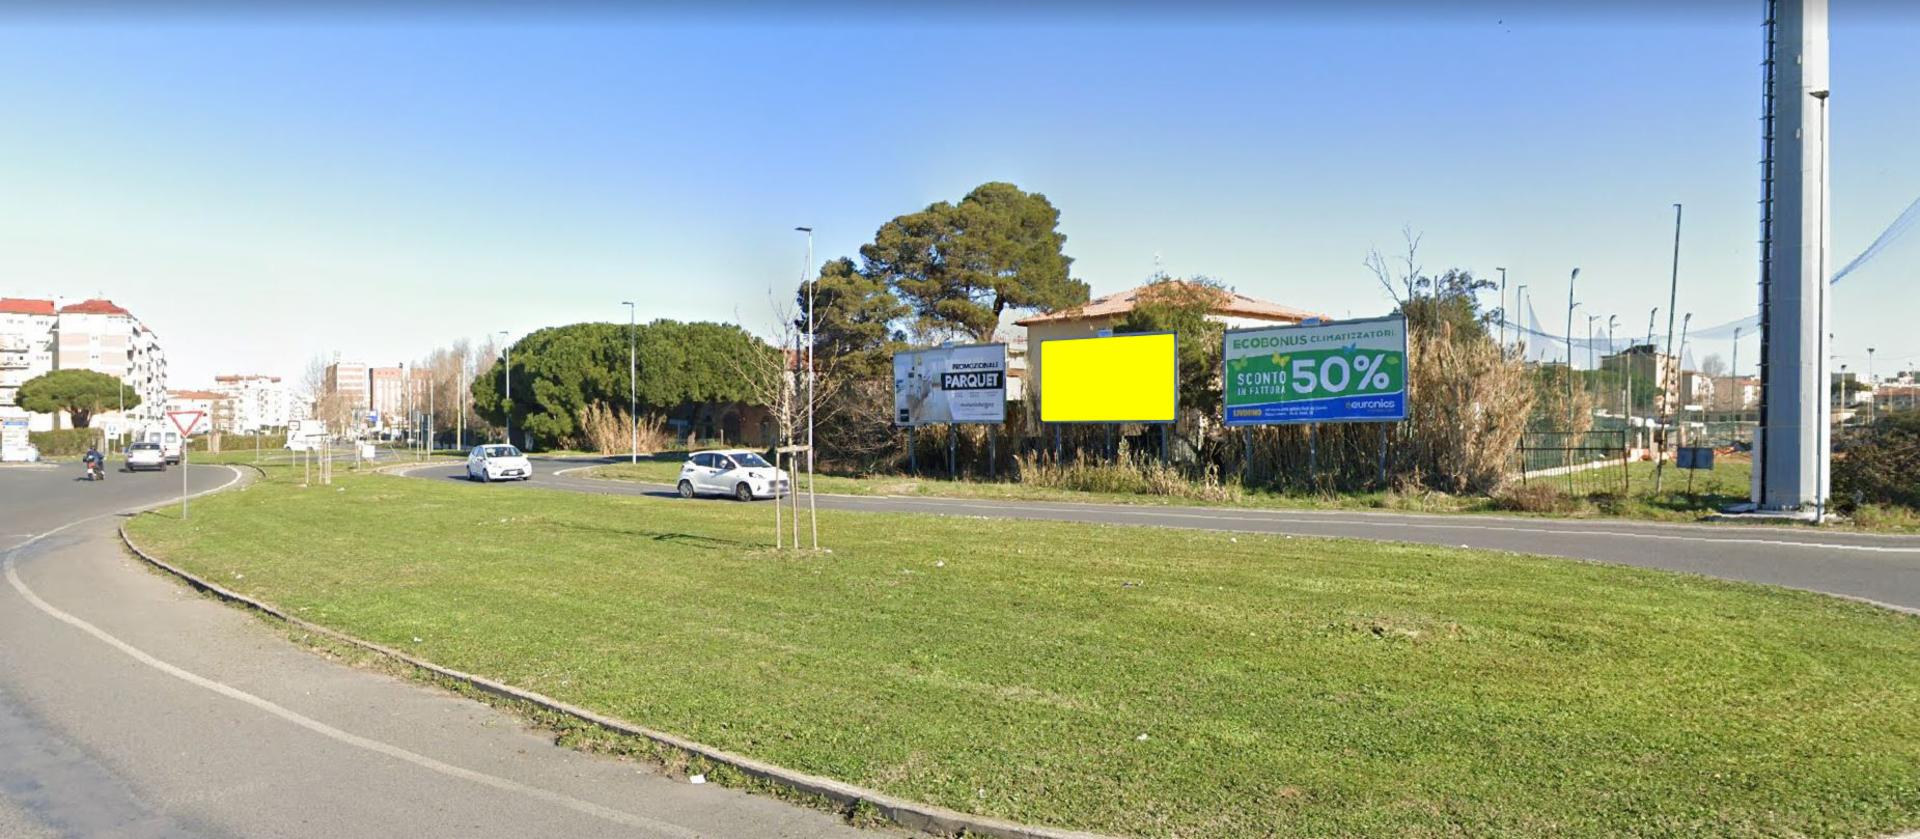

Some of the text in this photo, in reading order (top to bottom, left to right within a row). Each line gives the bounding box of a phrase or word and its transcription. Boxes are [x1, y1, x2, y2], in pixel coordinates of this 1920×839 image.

[1233, 329, 1395, 350] ECOBONUS CLIMATIZZATORI
[945, 373, 998, 388] PARQUET
[1237, 370, 1287, 386] SCONTO
[1291, 353, 1390, 394] 50%
[1237, 385, 1286, 396] IN FATTURA
[1351, 398, 1396, 409] euronics
